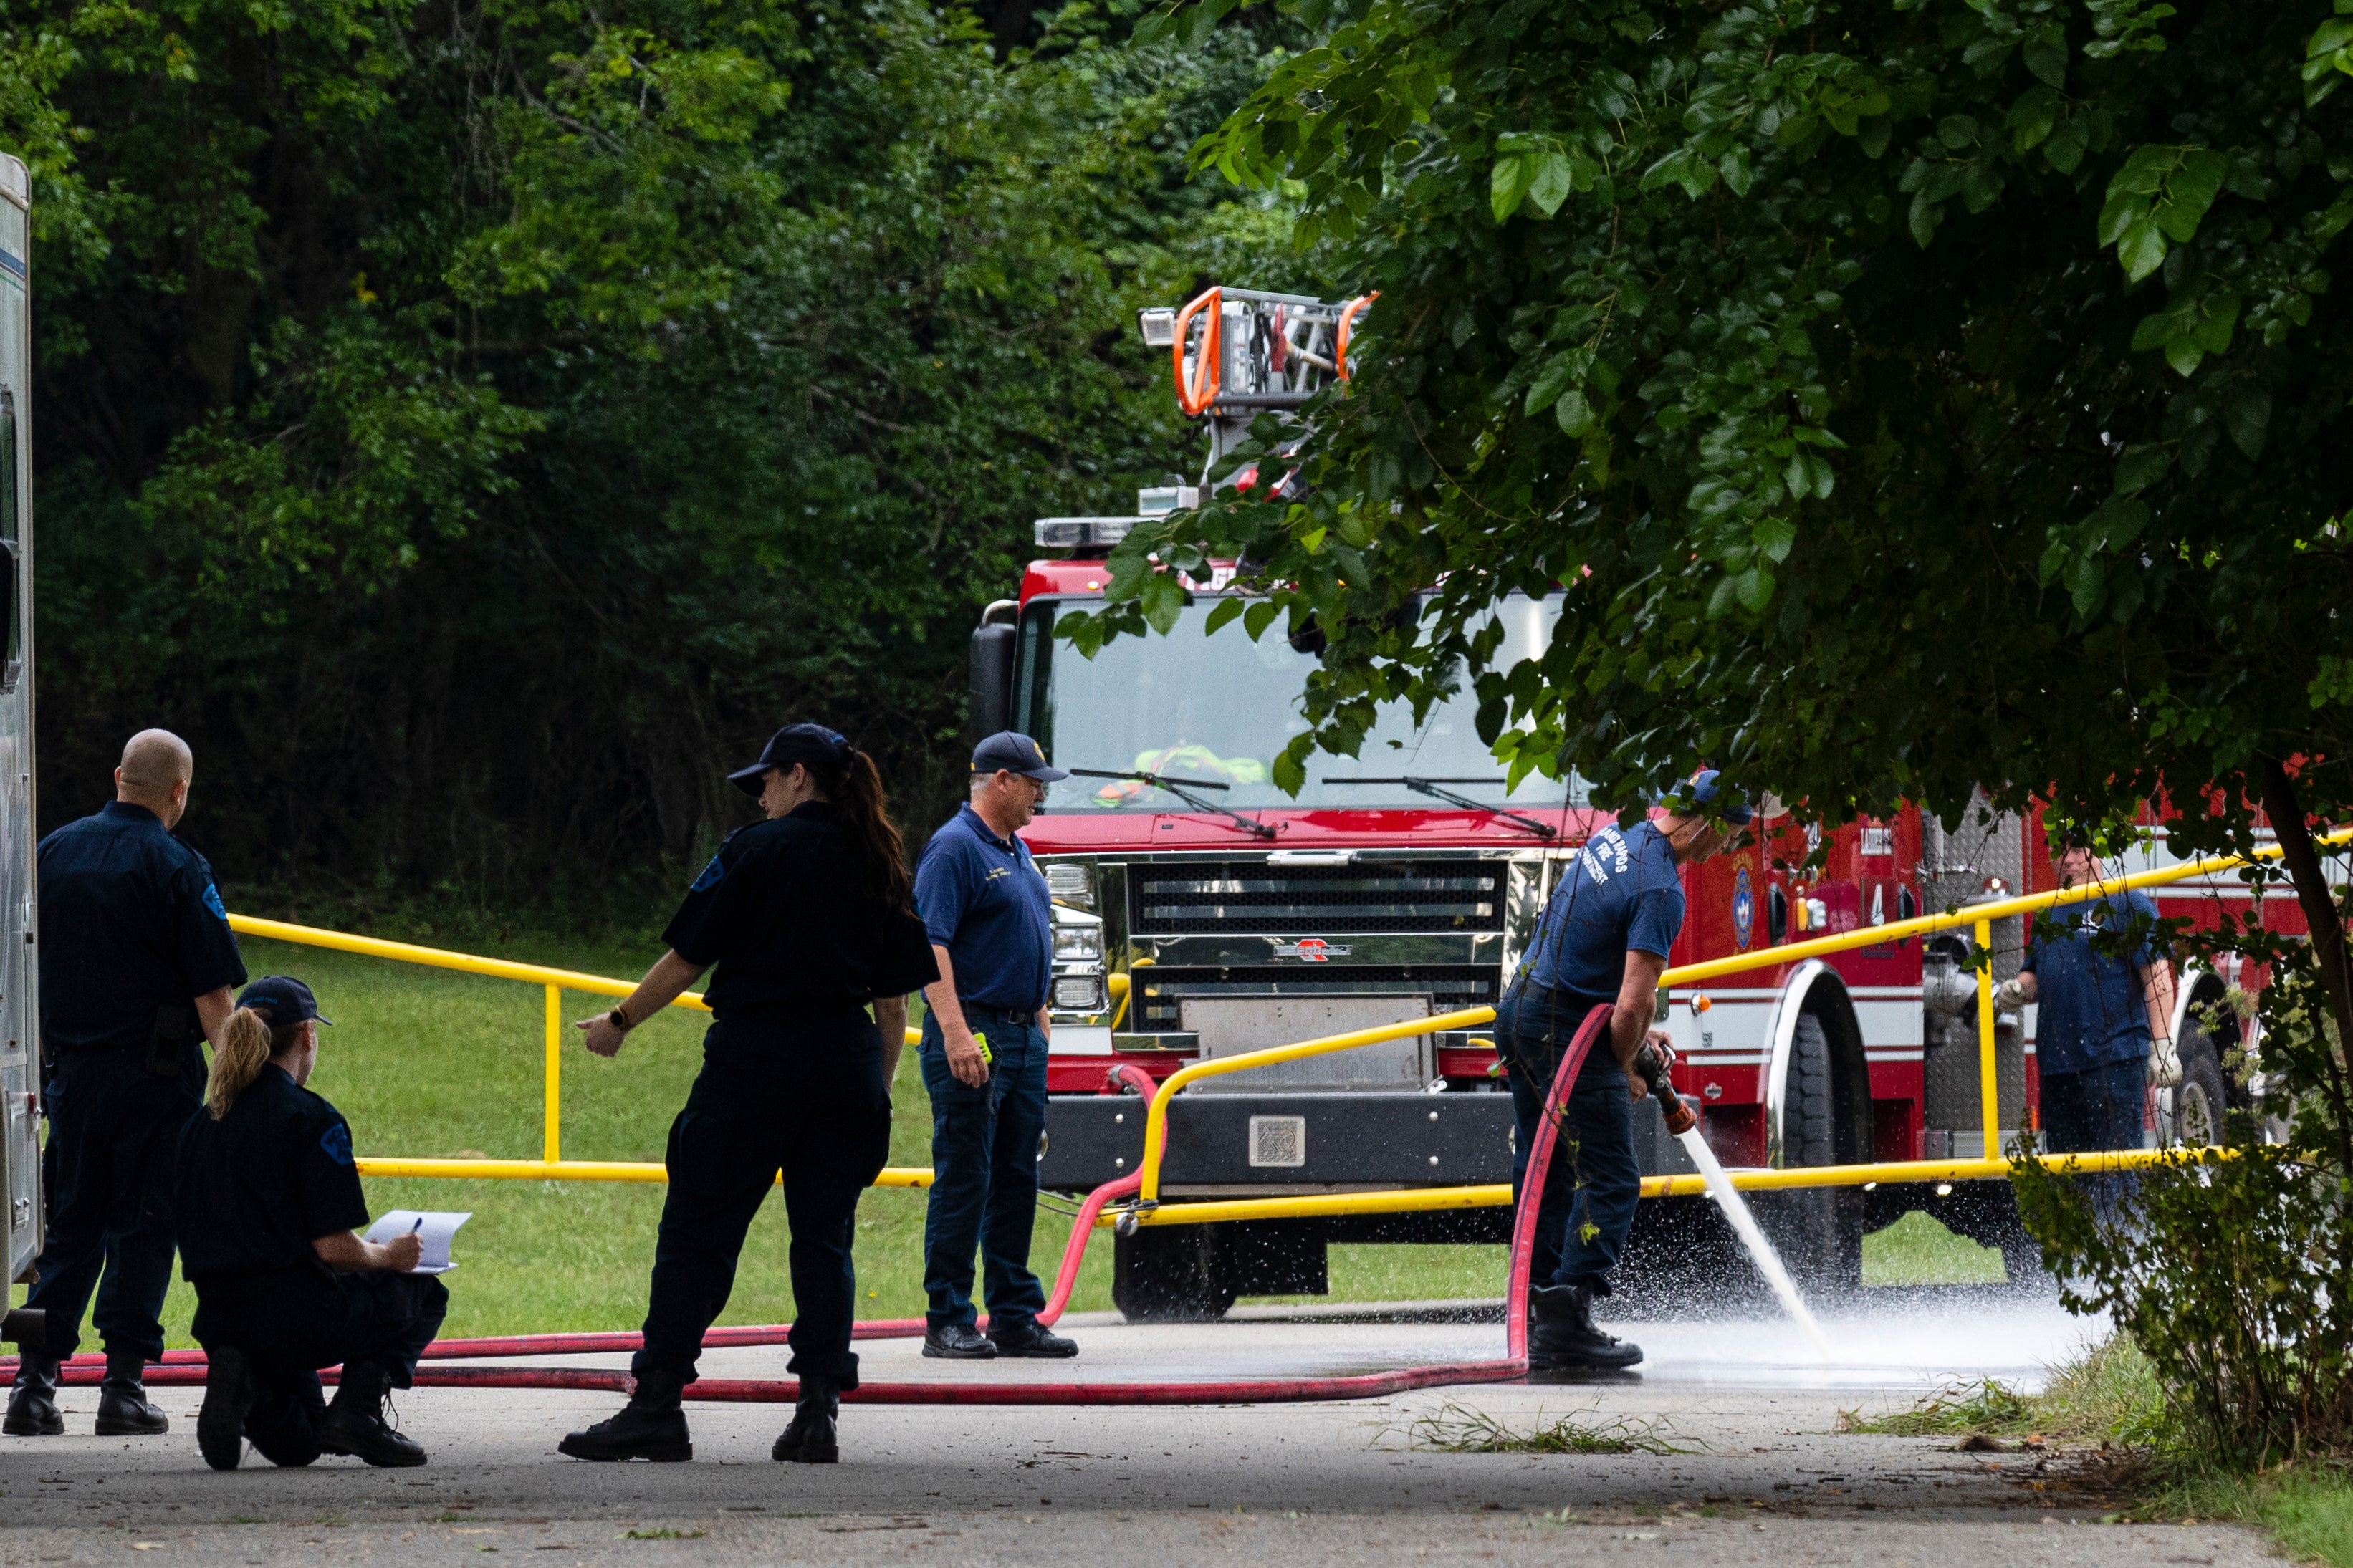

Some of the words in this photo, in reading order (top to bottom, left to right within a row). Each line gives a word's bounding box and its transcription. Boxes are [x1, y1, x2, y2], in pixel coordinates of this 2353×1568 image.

[1594, 827, 1621, 844] RAND
[1613, 840, 1628, 872] RAPIDS
[1596, 842, 1614, 862] FIRE
